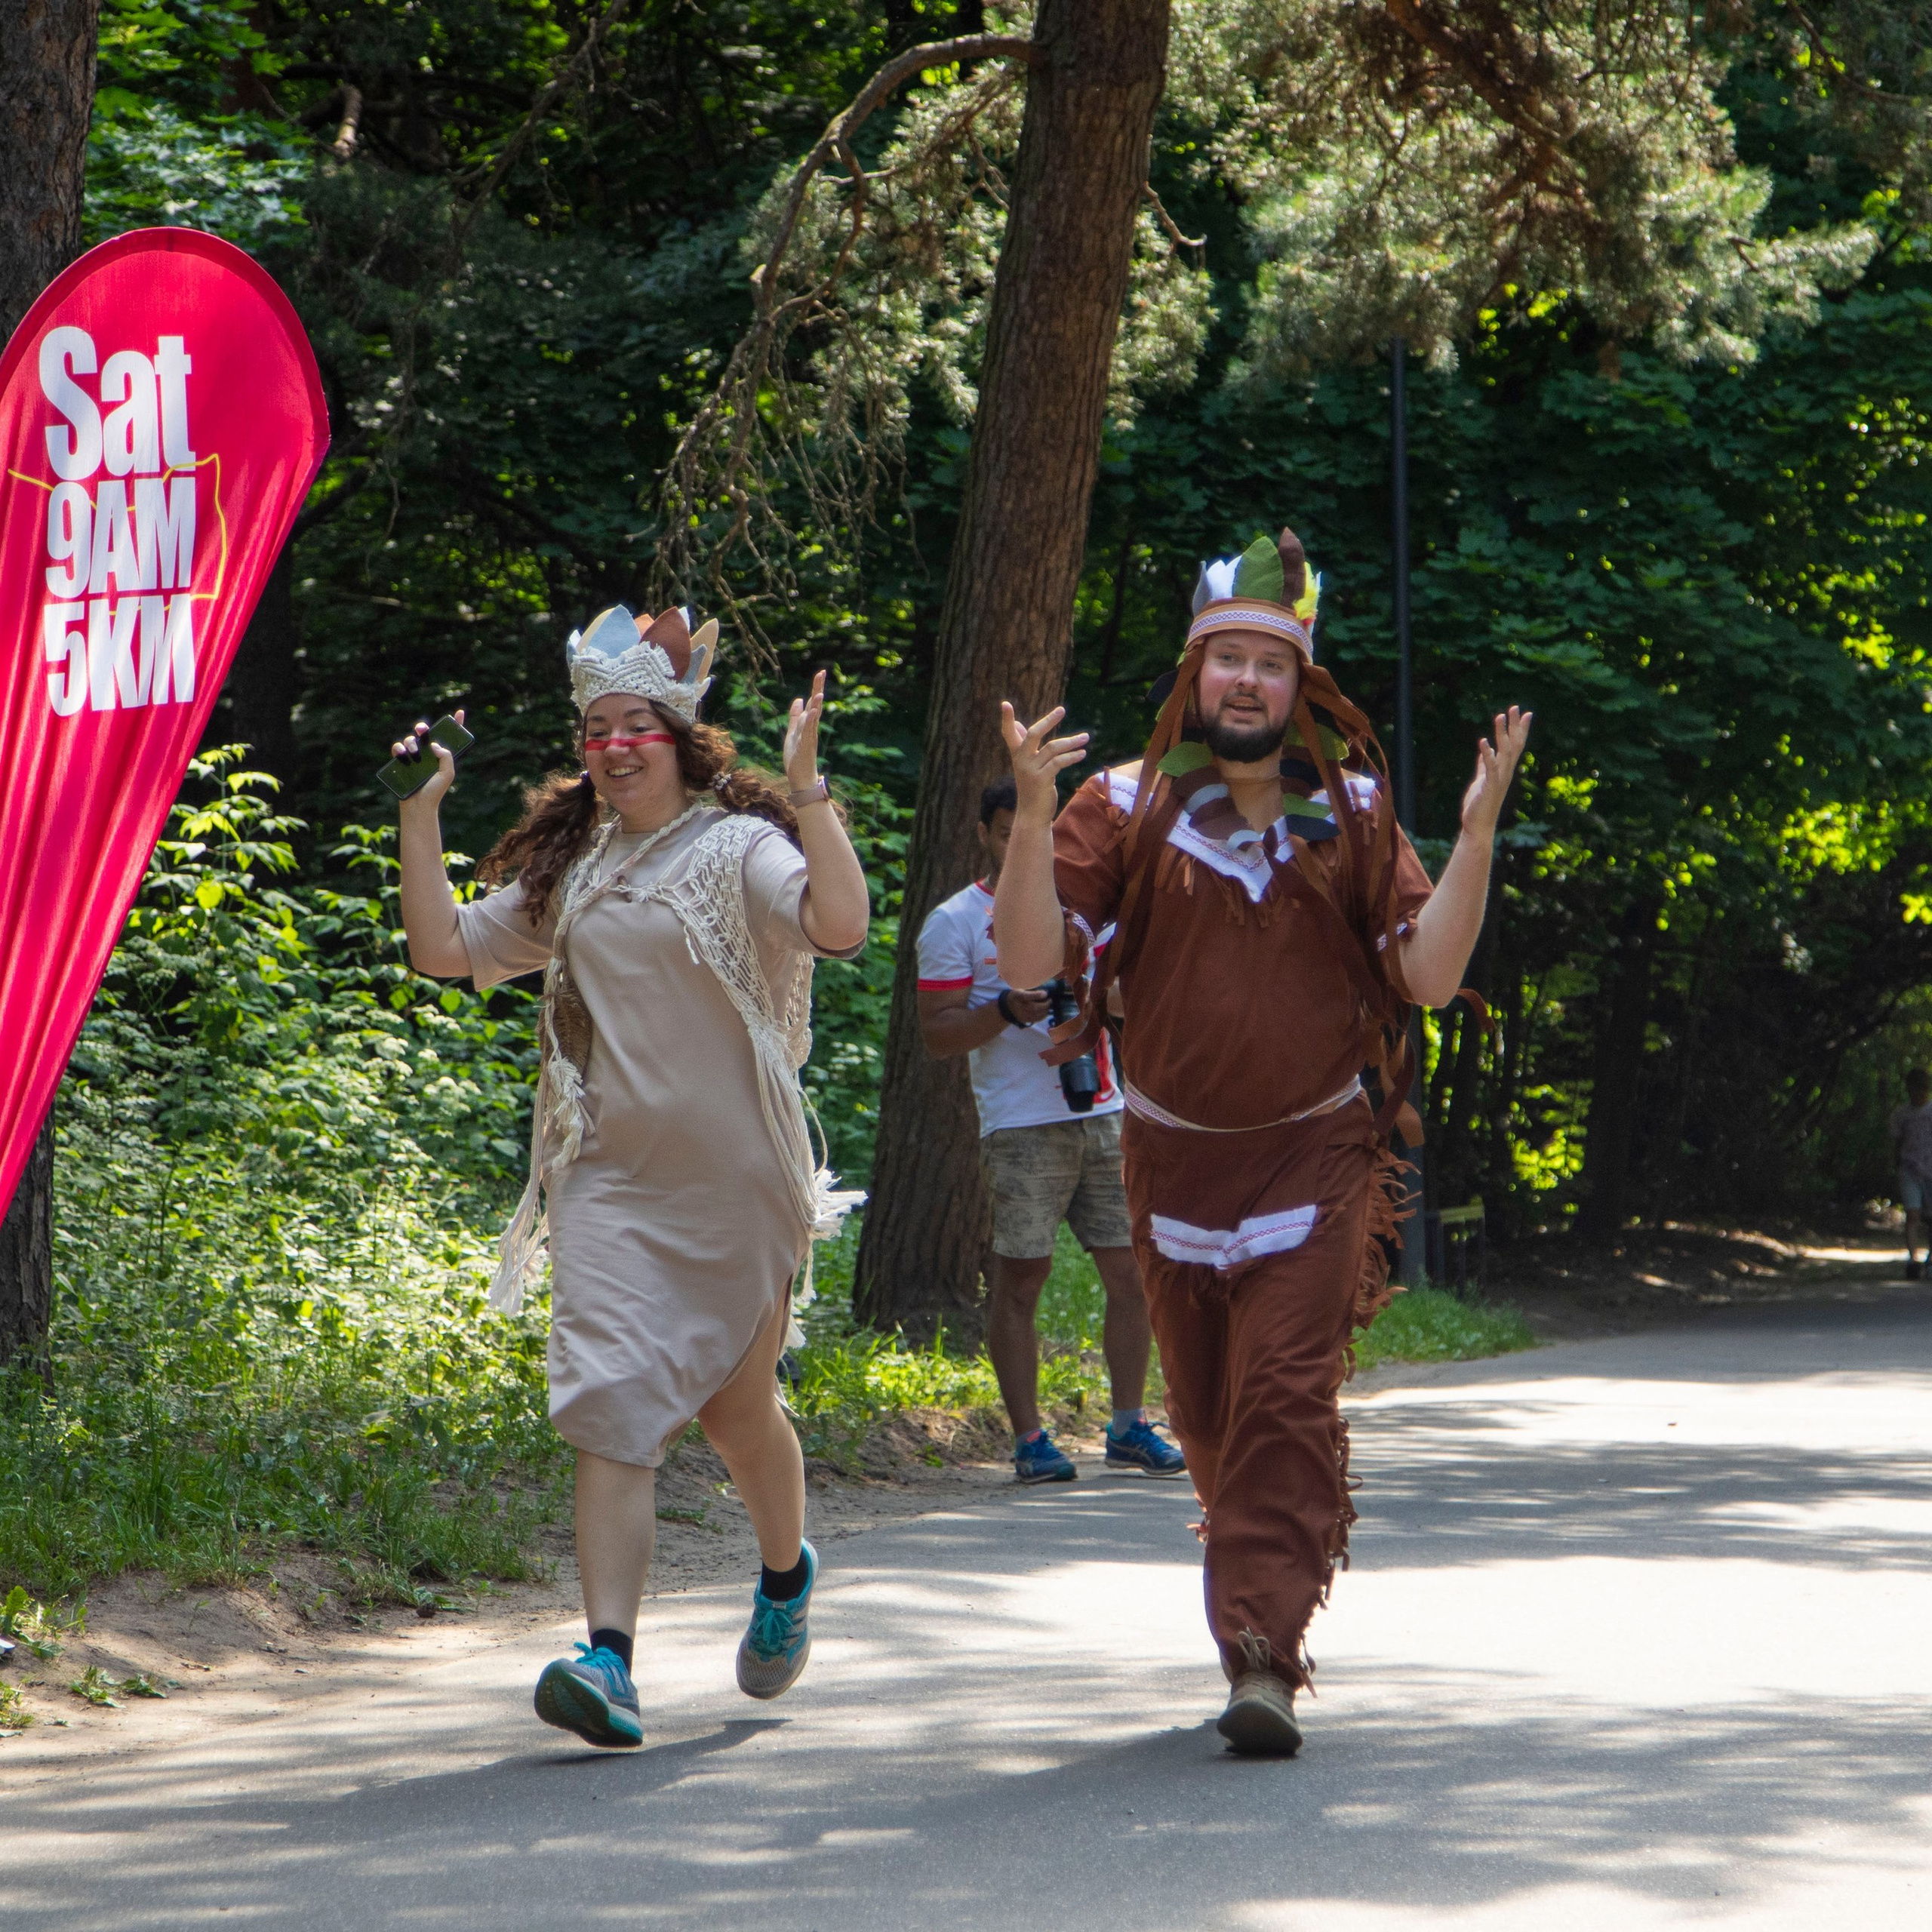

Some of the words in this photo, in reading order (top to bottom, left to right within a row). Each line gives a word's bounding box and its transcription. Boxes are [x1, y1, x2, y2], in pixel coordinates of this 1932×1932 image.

[39, 326, 195, 480] Sat
[46, 477, 195, 598] 9AM
[45, 593, 195, 717] 5KM
